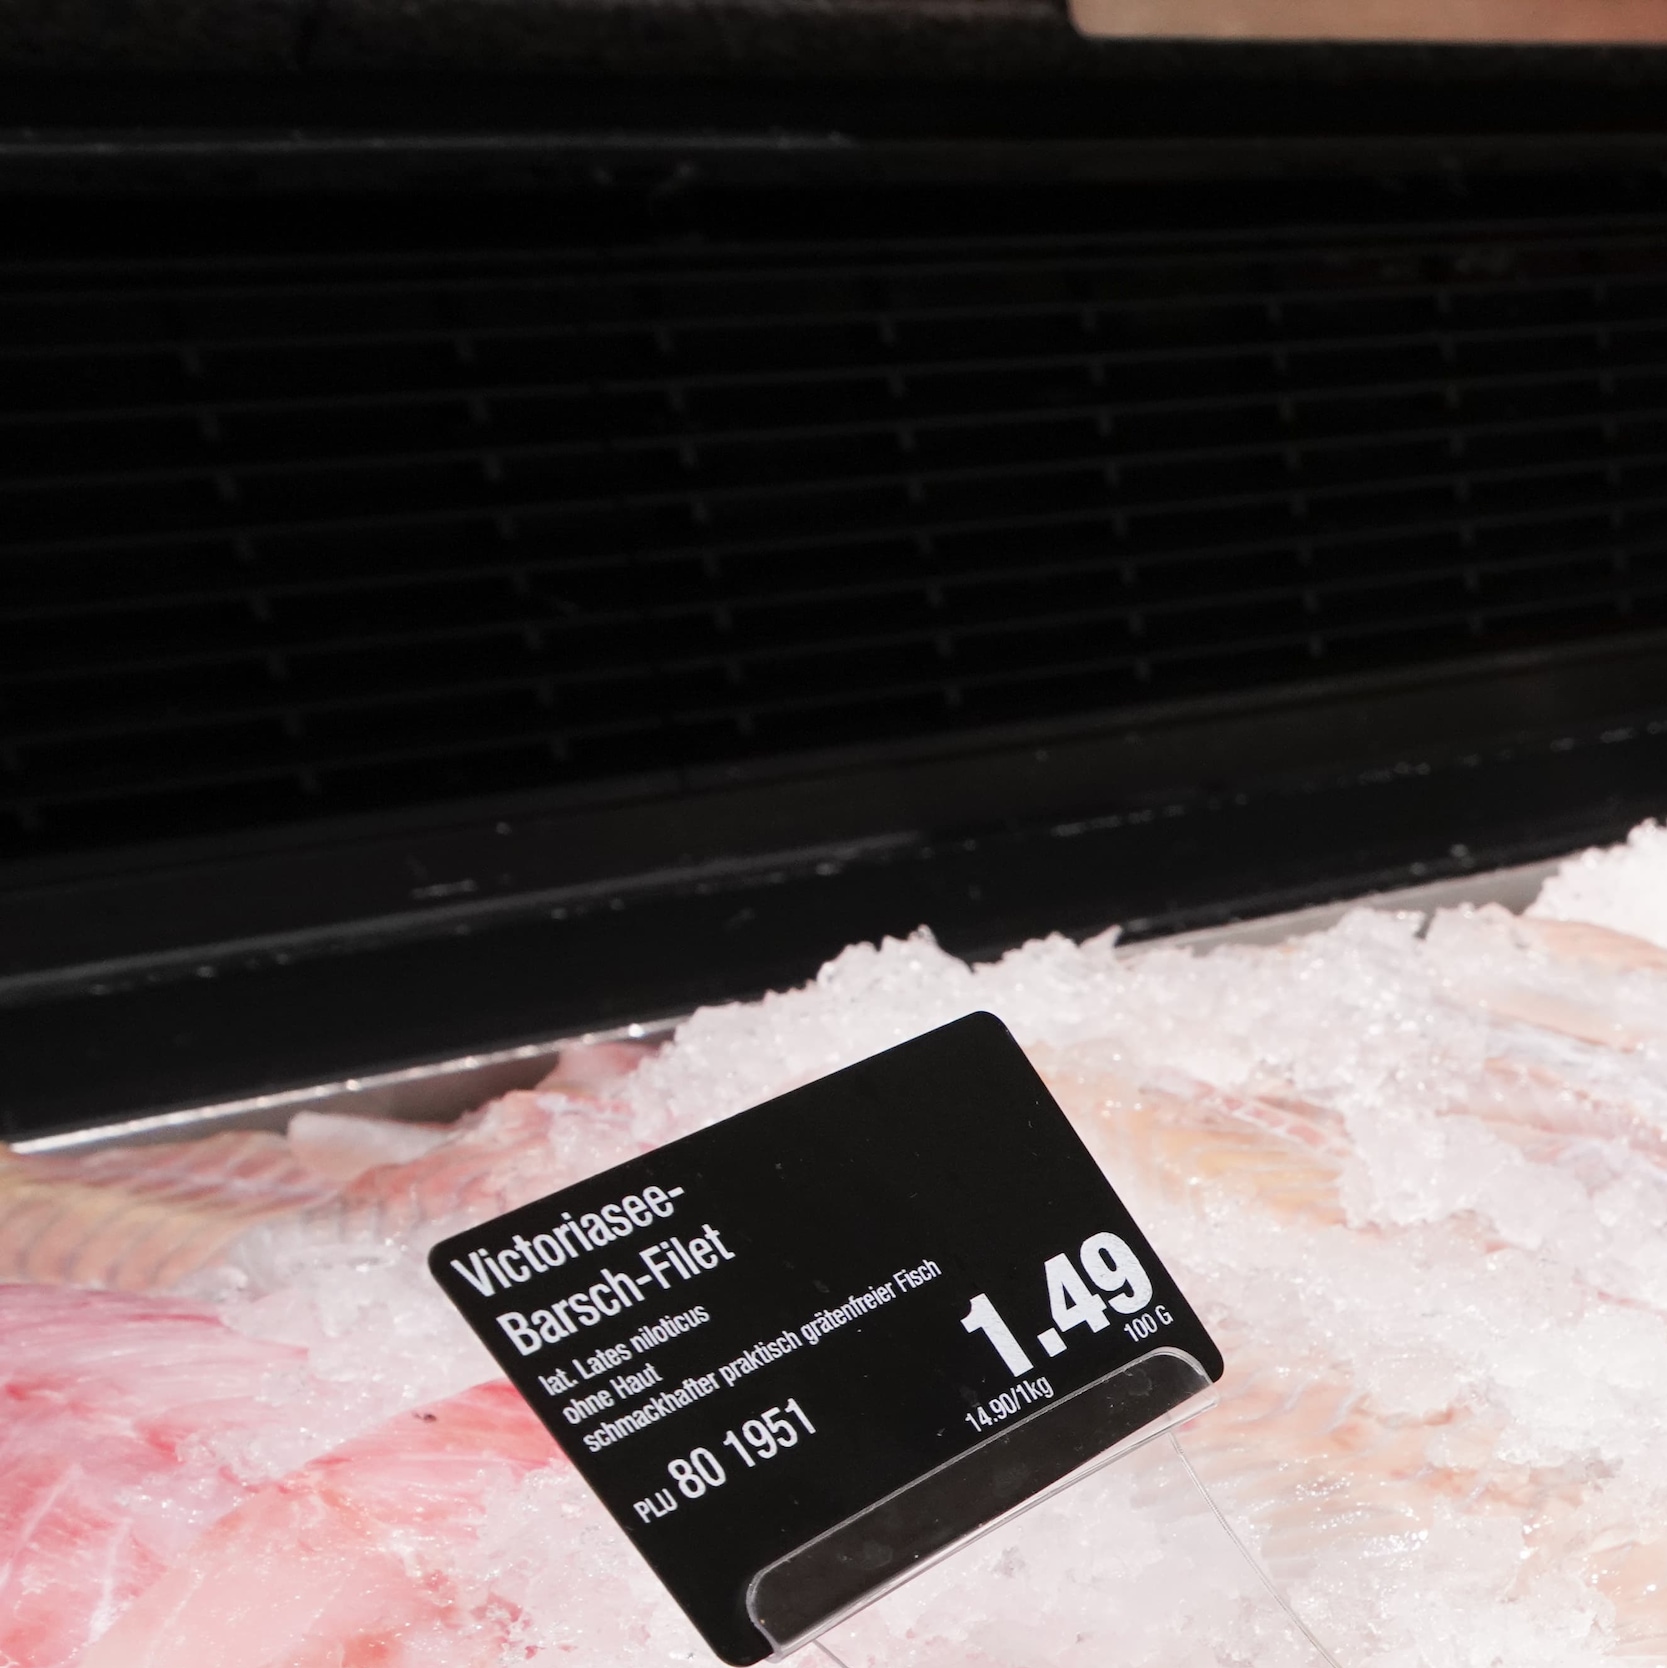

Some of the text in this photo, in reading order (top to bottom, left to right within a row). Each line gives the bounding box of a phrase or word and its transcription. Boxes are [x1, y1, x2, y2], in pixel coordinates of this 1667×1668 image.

[450, 1185, 686, 1297] Victoriasee-
[496, 1223, 736, 1356] Barsch-Filet
[538, 1304, 710, 1396] lat. Lates niloticus
[582, 1258, 942, 1453] schmackhafter praktisch grätenfreier Fisch
[960, 1231, 1153, 1377] 1.49
[1123, 1305, 1174, 1342] 100 G
[562, 1362, 663, 1425] ohne Haut
[965, 1376, 1054, 1432] 14.90/1kg
[633, 1398, 816, 1523] PLU 80 1951
